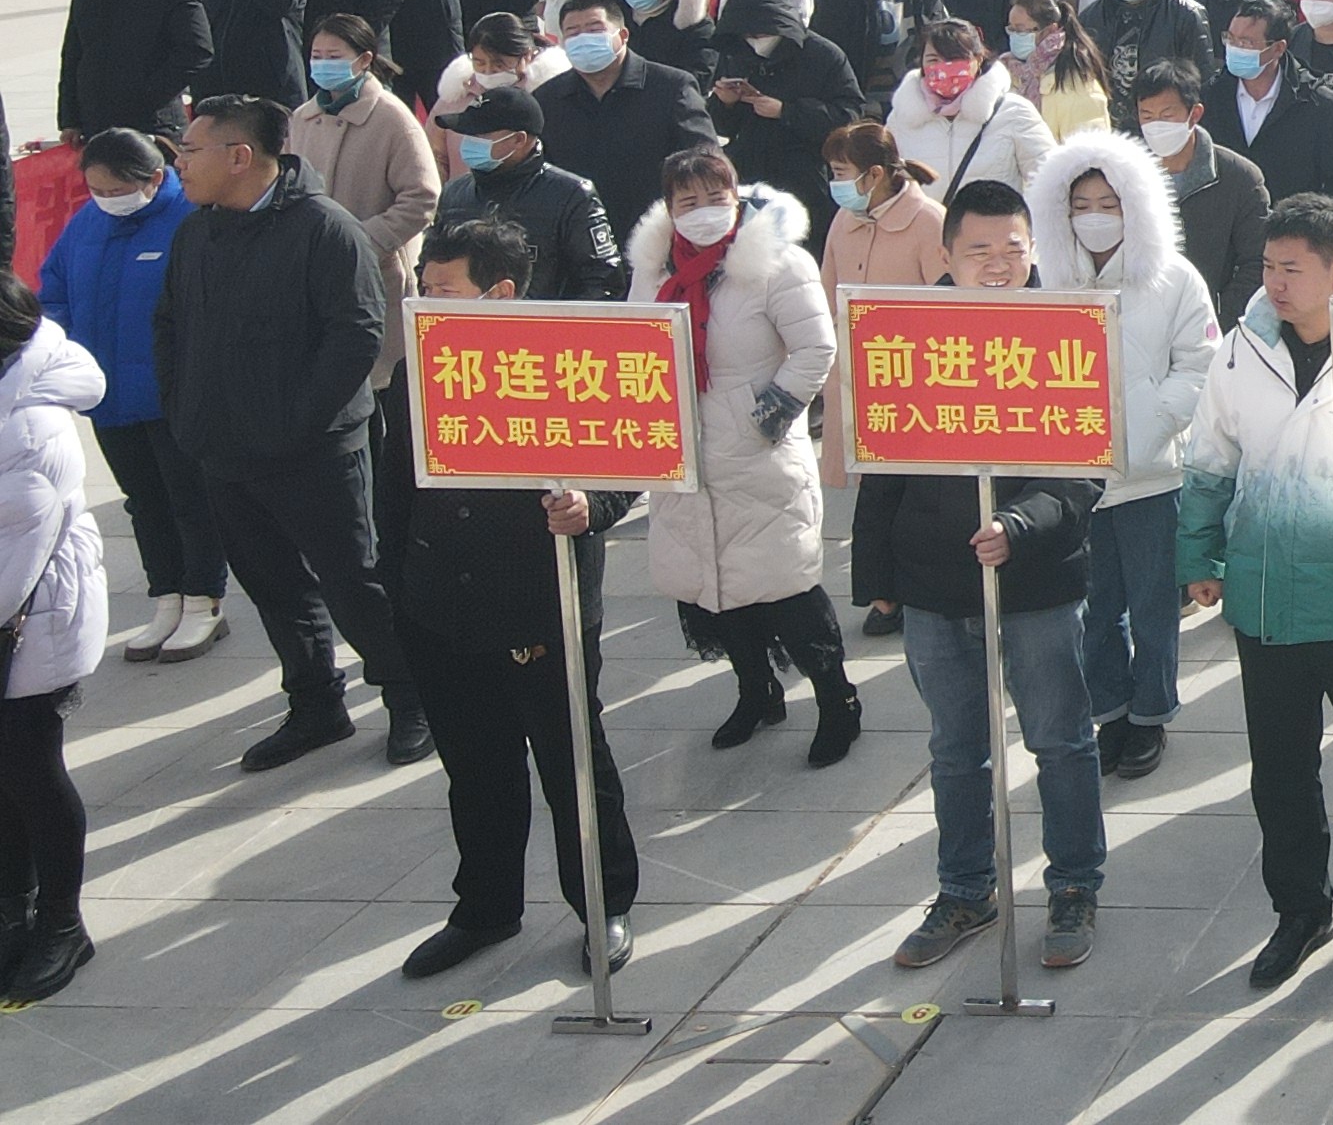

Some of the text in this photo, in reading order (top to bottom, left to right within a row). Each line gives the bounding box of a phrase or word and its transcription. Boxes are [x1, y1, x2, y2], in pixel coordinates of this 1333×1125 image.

[433, 346, 671, 403] 祁连牧歌
[863, 335, 1100, 389] 前进牧业
[437, 414, 679, 450] 新入职员工代表
[866, 402, 1106, 436] 新入职员工代表
